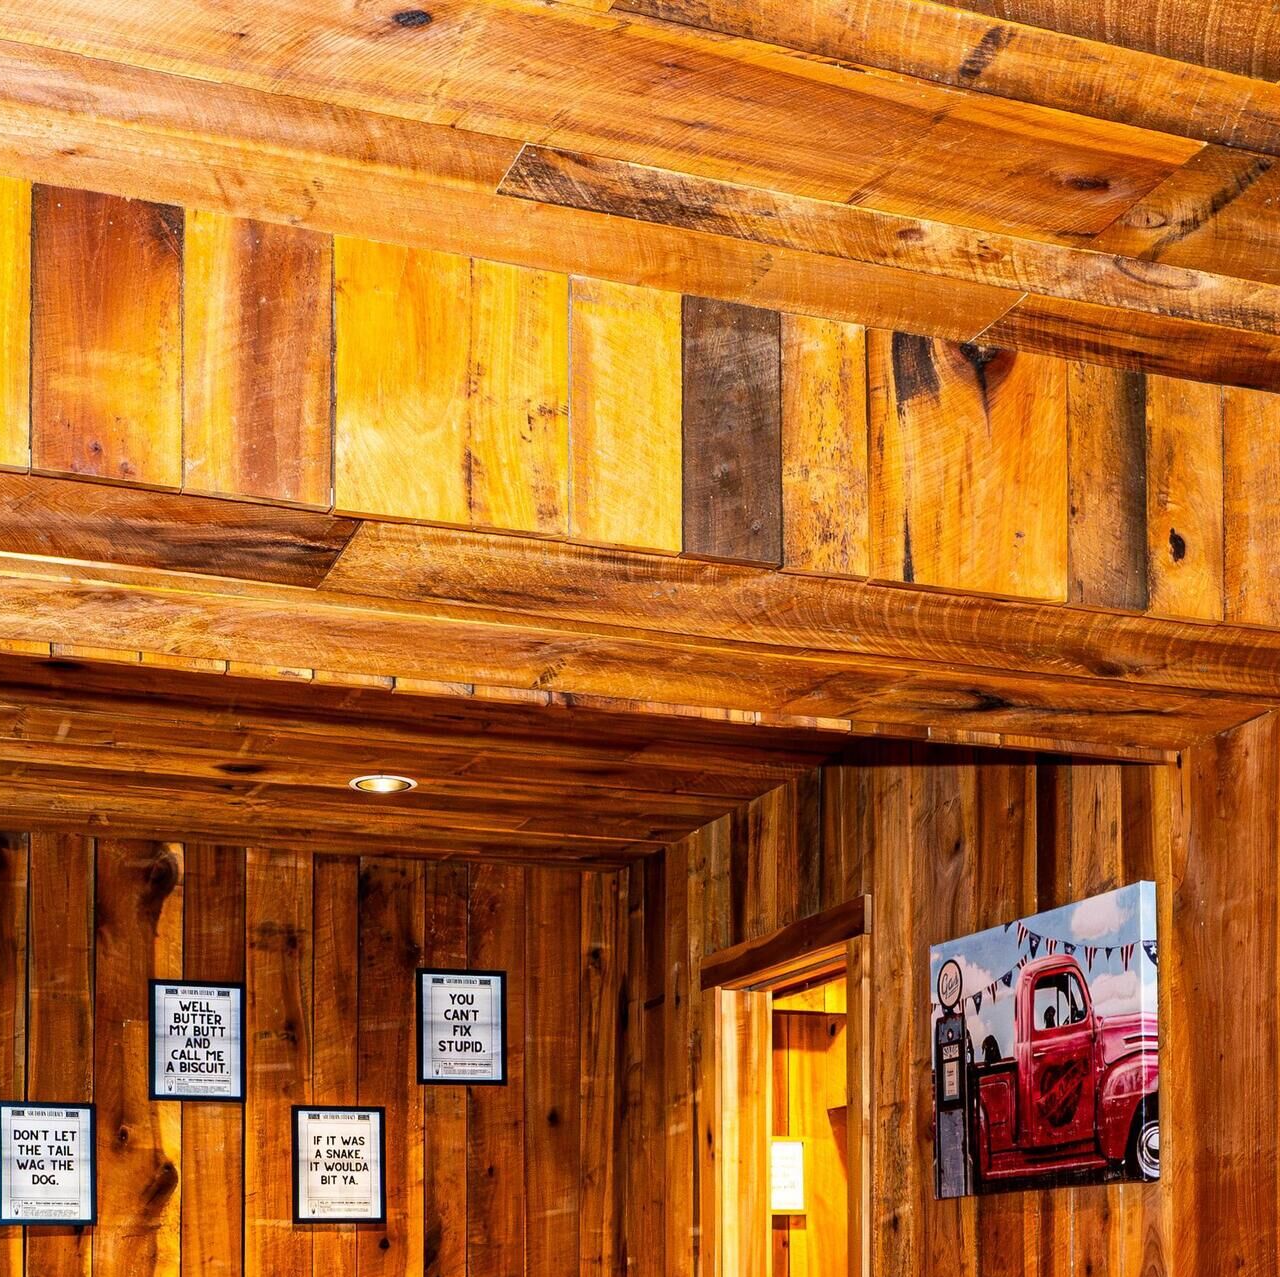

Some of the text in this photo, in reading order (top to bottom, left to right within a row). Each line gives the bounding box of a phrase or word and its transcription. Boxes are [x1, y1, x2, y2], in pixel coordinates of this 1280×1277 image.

[449, 993, 475, 1006] YOU
[179, 1001, 216, 1014] WELL,
[173, 1013, 222, 1025] BUTTER
[444, 1009, 480, 1022] CAN'T
[169, 1025, 226, 1037] MY BUTT
[453, 1025, 472, 1037] FIX
[185, 1038, 211, 1049] AND
[438, 1040, 486, 1053] STUPID.
[171, 1050, 224, 1062] CALL ME
[166, 1061, 229, 1074] A BISCUIT.
[13, 1130, 77, 1141] DON'T LET
[313, 1136, 365, 1146] IF IT WAS
[17, 1144, 74, 1156] THE TAIL
[315, 1149, 322, 1159] A
[16, 1159, 74, 1171] WAG THE
[310, 1162, 369, 1172] IT WOULDA
[32, 1174, 59, 1186] DOG.
[321, 1175, 358, 1185] BIT YA.
